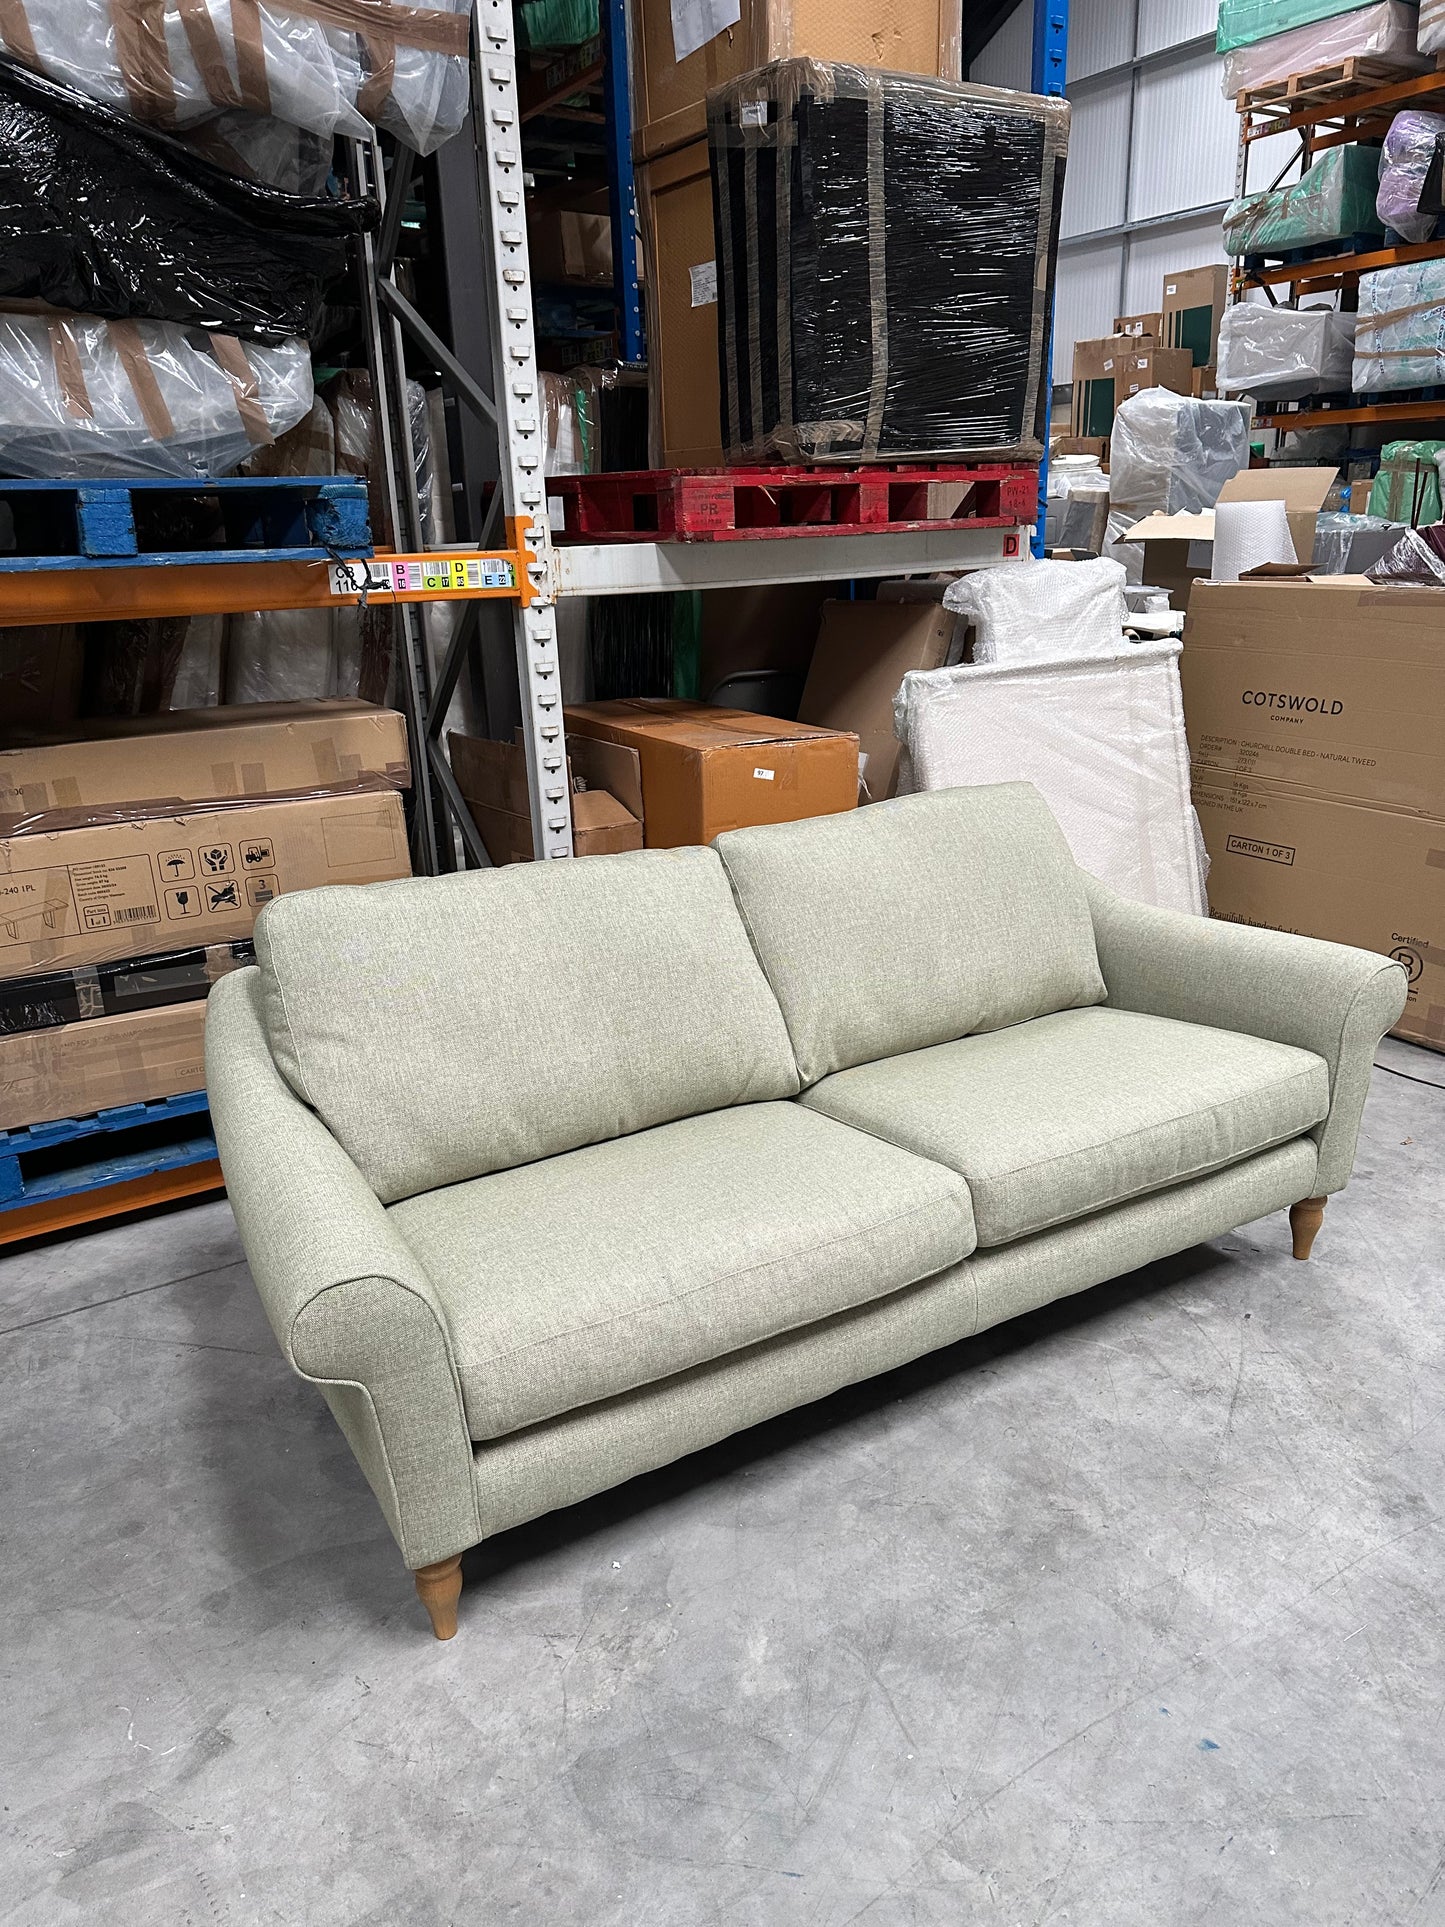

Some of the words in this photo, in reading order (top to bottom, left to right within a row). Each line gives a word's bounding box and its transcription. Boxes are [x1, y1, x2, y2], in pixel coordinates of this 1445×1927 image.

[1005, 536, 1017, 554] D
[395, 564, 405, 575] B
[455, 562, 464, 573] D
[398, 579, 406, 589] 16
[427, 577, 436, 588] C
[442, 577, 450, 588] 17
[485, 575, 493, 585] E
[1242, 690, 1343, 715] COTSWOLD
[1270, 715, 1304, 724] COMPANY
[1201, 734, 1237, 746] DESCRIPTION
[1241, 740, 1274, 752] CHURCHILL
[1275, 745, 1301, 756] DOUBLE
[1302, 749, 1315, 758] BED
[1320, 752, 1350, 763] NATURAL
[1351, 756, 1377, 767] TWEED
[1231, 839, 1264, 854] CARTON
[1272, 848, 1284, 858] OF
[1285, 851, 1291, 860] 3
[258, 879, 266, 890] 3
[1391, 932, 1430, 949] Certified
[180, 1066, 206, 1077] CARTO
